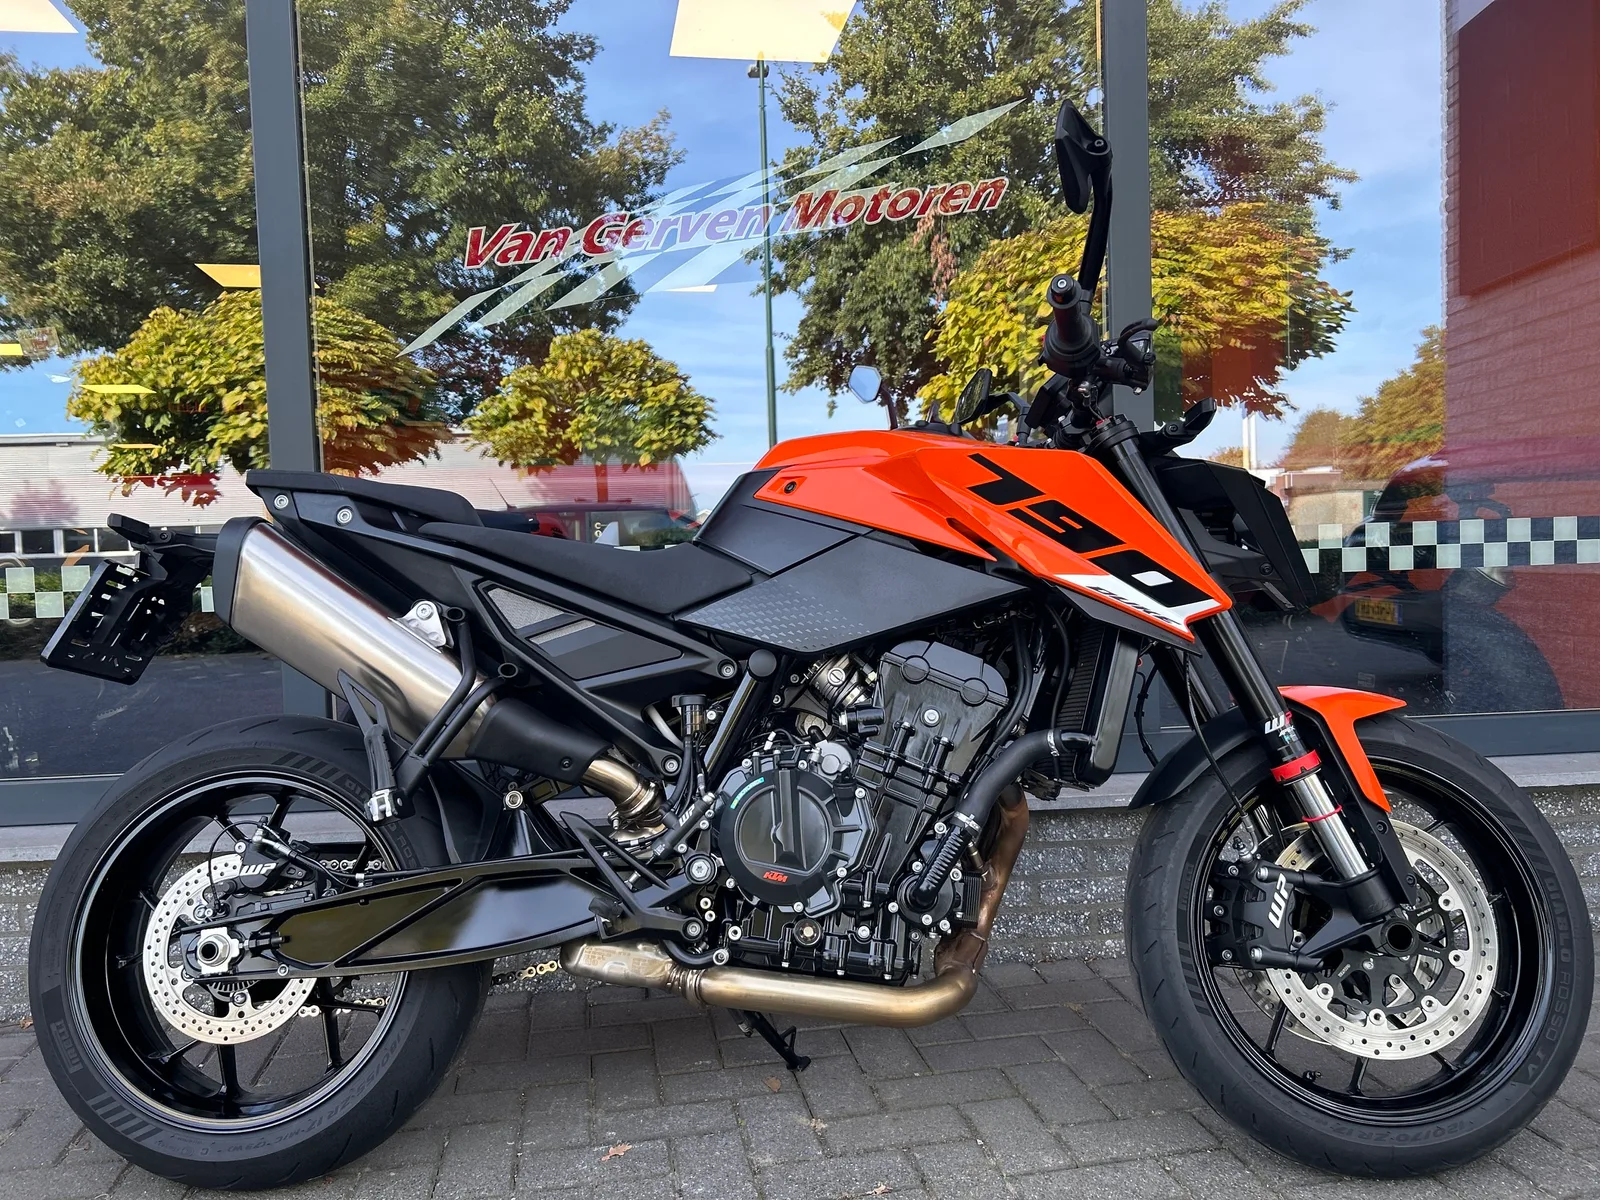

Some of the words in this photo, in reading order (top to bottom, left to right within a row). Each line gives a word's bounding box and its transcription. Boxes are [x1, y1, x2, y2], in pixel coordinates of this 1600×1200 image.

[465, 223, 574, 269] Van
[581, 203, 775, 257] Gerven
[779, 177, 1009, 234] Motoren
[966, 452, 1214, 608] 790
[1264, 710, 1293, 734] WP
[678, 803, 695, 827] WP
[240, 862, 277, 876] WP
[763, 870, 788, 883] KTM
[1268, 872, 1289, 929] WP
[1543, 876, 1572, 963] DIABLO
[1545, 970, 1572, 1042] ROSSO
